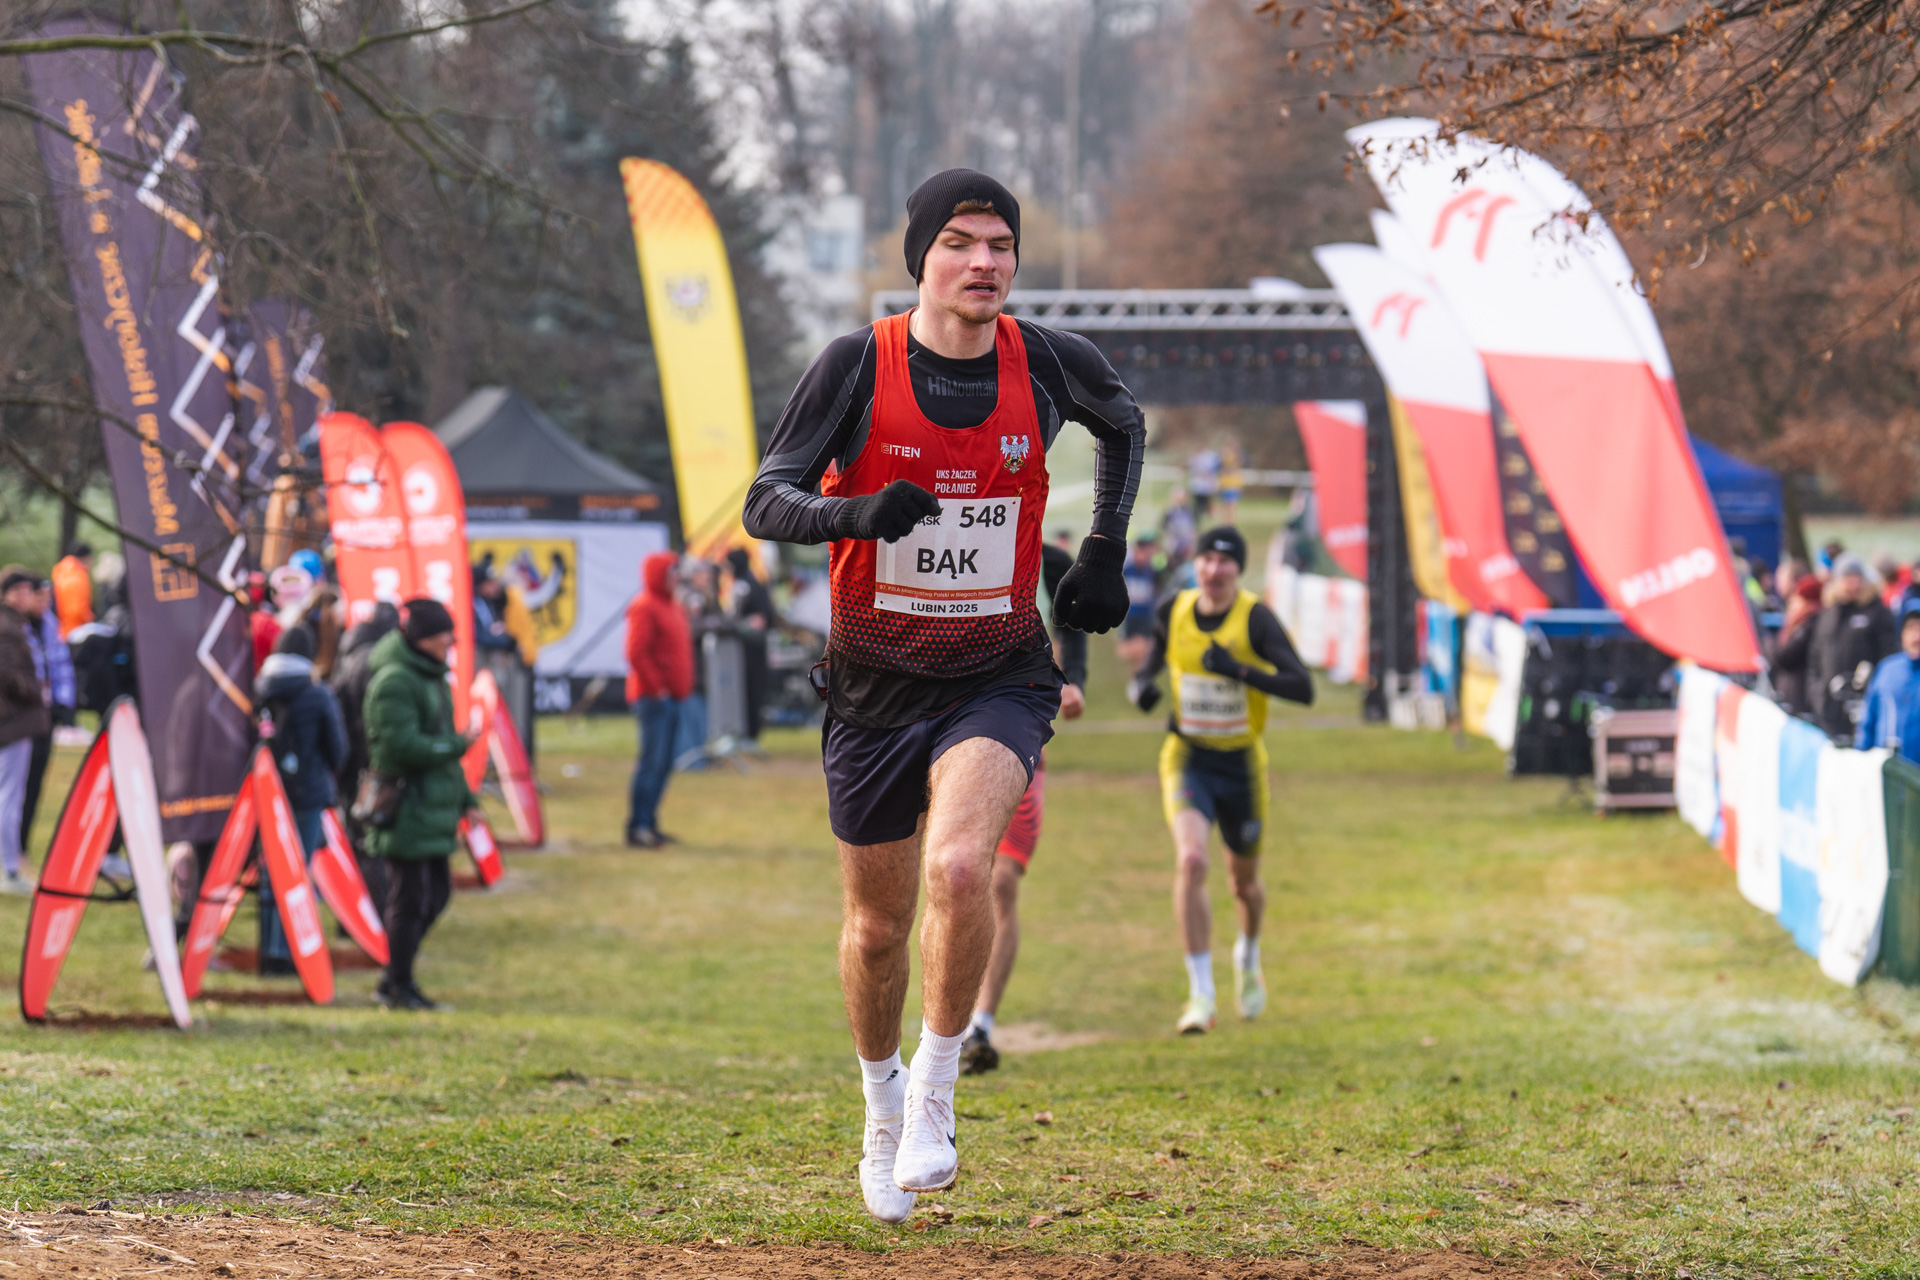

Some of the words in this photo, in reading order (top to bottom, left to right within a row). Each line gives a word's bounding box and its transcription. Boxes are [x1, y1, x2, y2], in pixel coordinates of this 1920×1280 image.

[936, 470, 950, 479] UKS
[950, 468, 977, 479] ŻACZEK
[934, 482, 977, 494] POŁANIEC
[959, 504, 1006, 528] 548
[916, 548, 979, 580] BĄK
[901, 588, 932, 598] Mistrzostwa
[956, 591, 977, 599] Biegach
[911, 602, 946, 613] LUBIN
[949, 604, 978, 613] 2025
